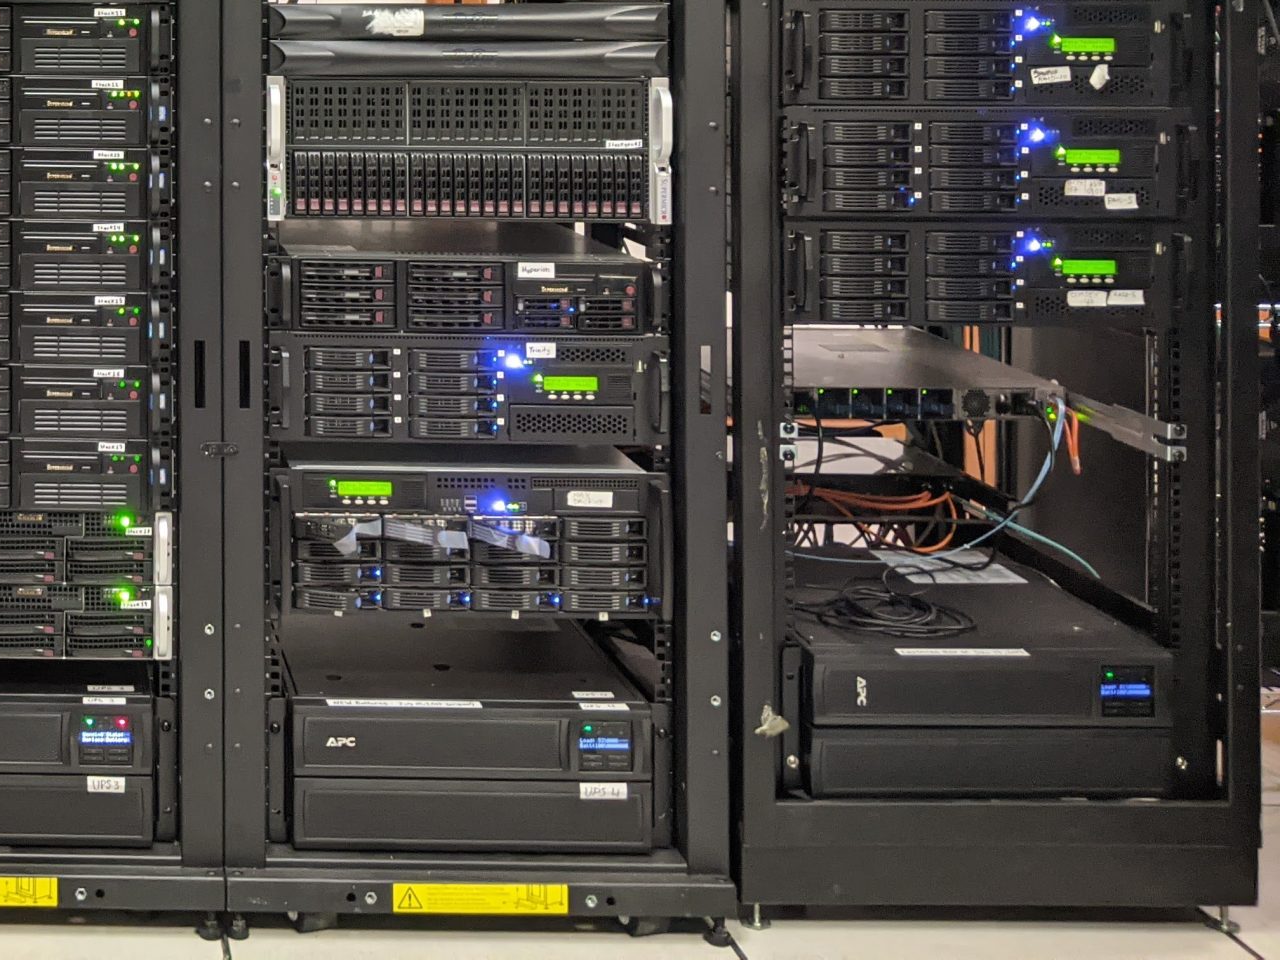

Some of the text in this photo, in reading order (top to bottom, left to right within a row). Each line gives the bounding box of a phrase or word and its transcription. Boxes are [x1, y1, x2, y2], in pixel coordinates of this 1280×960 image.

[856, 675, 868, 706] APC
[326, 736, 356, 747] APC
[92, 780, 120, 791] UPS 3
[584, 786, 620, 798] UPS 4
